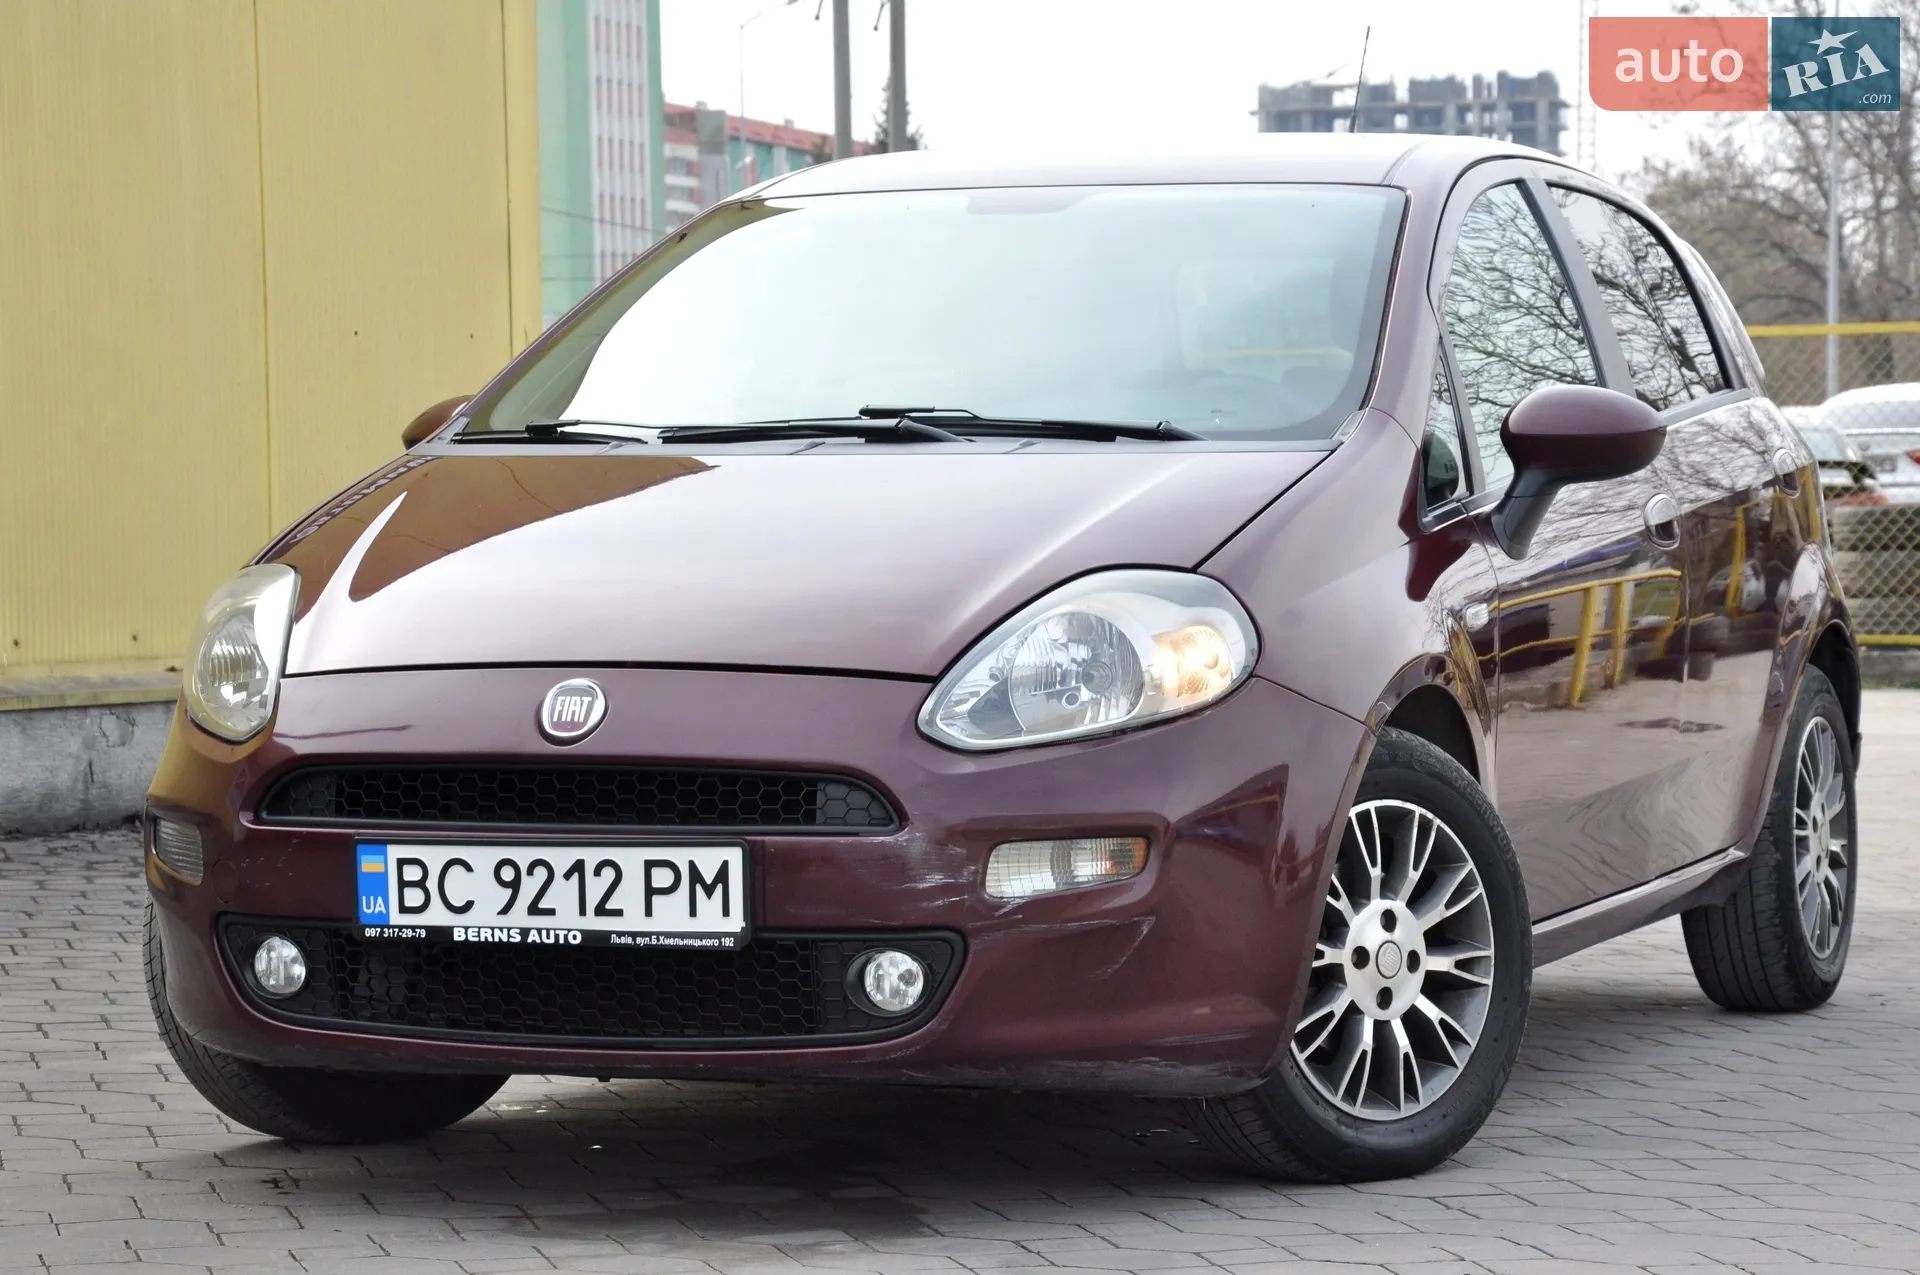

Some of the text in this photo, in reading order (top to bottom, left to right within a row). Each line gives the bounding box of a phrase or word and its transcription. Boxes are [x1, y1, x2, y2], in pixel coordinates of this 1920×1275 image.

[553, 696, 592, 722] FIAT
[396, 857, 730, 918] BC 9212 PM
[362, 895, 386, 914] UA
[365, 927, 426, 938] 097 317-29-79
[453, 927, 582, 945] BERNS AUTO
[610, 934, 635, 945] Львів,
[721, 937, 734, 947] 192
